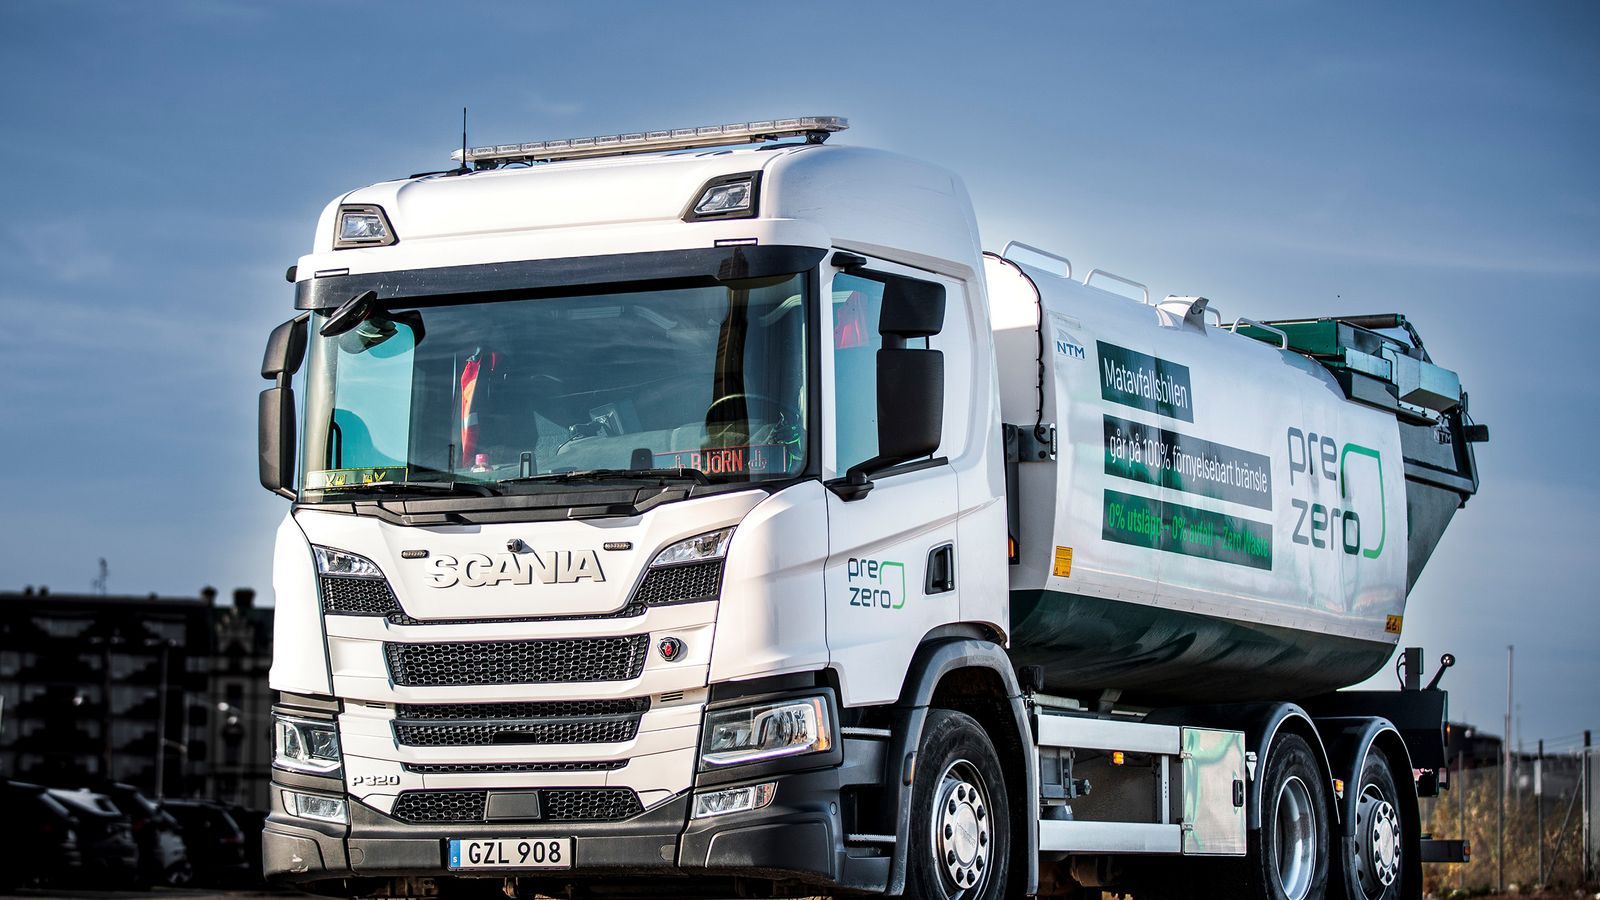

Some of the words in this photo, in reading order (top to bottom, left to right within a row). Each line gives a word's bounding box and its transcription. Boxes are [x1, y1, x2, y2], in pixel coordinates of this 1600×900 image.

[1056, 340, 1085, 359] NTM
[1103, 357, 1188, 409] Matavfallsbilen
[691, 449, 744, 475] BJÖRN
[1109, 428, 1127, 464] går
[1128, 432, 1141, 468] på
[1142, 438, 1171, 470] 100%
[1172, 444, 1234, 486] förnyelsebart
[1235, 460, 1268, 493] bränsle
[1287, 426, 1338, 487] pre
[1108, 502, 1126, 530] 0%
[1127, 508, 1162, 542] utsläpp
[1172, 515, 1187, 542] 0%
[1189, 520, 1214, 547] avfall
[1222, 526, 1241, 553] Zero
[1243, 528, 1269, 558] Waste
[1291, 497, 1361, 556] zero
[424, 550, 606, 589] SCANIA
[847, 557, 879, 583] pre
[849, 586, 891, 609] zero
[352, 774, 401, 787] P320
[468, 842, 510, 864] GZL
[517, 841, 561, 864] 908
